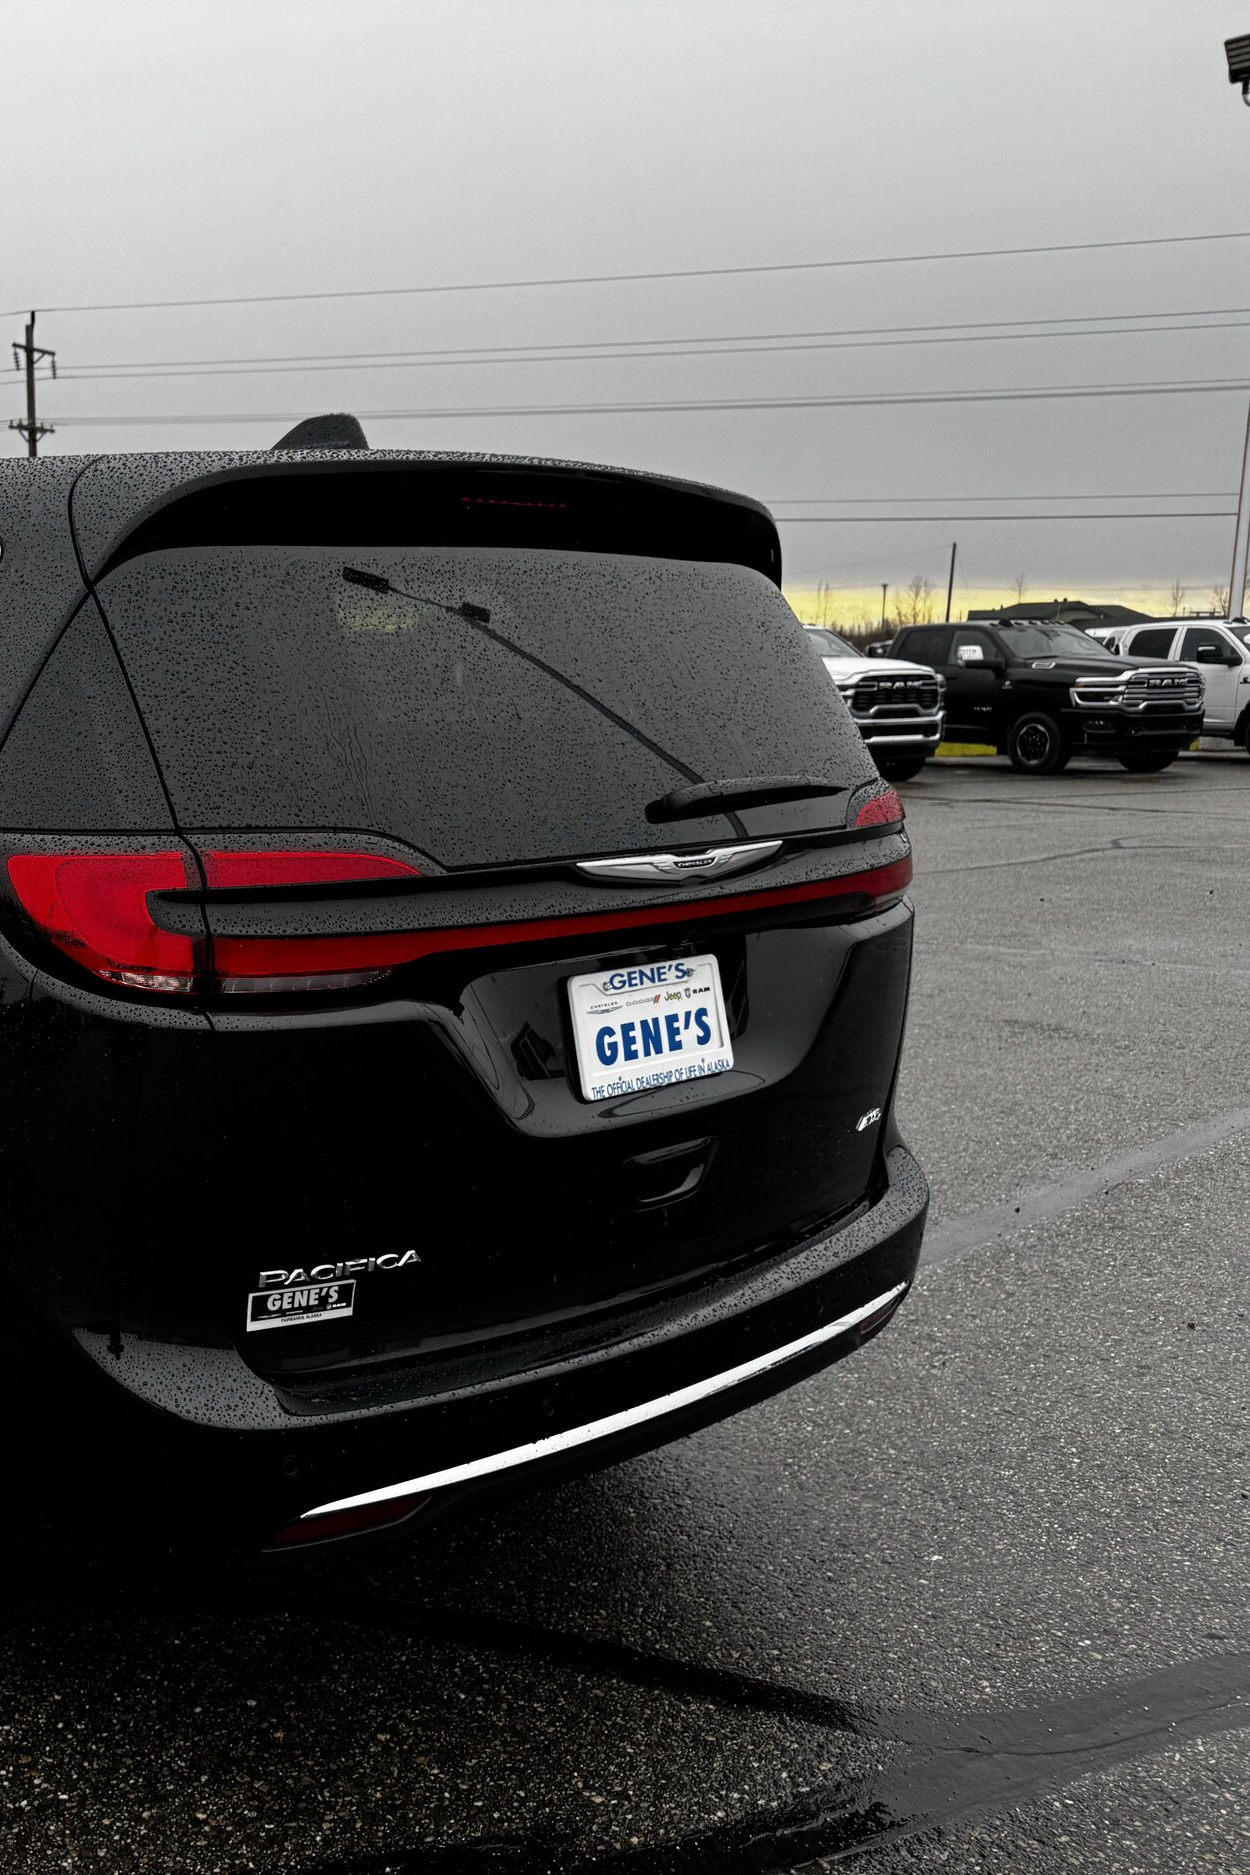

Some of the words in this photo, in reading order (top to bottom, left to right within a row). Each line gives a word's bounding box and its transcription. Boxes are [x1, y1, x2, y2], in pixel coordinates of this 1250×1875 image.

[879, 681, 922, 690] RAM
[1149, 678, 1188, 687] RAM
[677, 859, 712, 867] CHRYSLER
[608, 962, 687, 991] GENE'S
[664, 991, 682, 1001] Jeep
[596, 1007, 712, 1066] GENE'S
[591, 1085, 605, 1099] THE
[607, 1079, 635, 1096] OFFICIAL
[636, 1071, 673, 1089] DEALERSHIP
[674, 1068, 685, 1081] OF
[686, 1064, 698, 1079] LIFE
[698, 1062, 706, 1075] IN
[707, 1058, 731, 1073] ALASKA
[258, 1249, 422, 1288] PACIFICA
[266, 1285, 339, 1312] GENE'S
